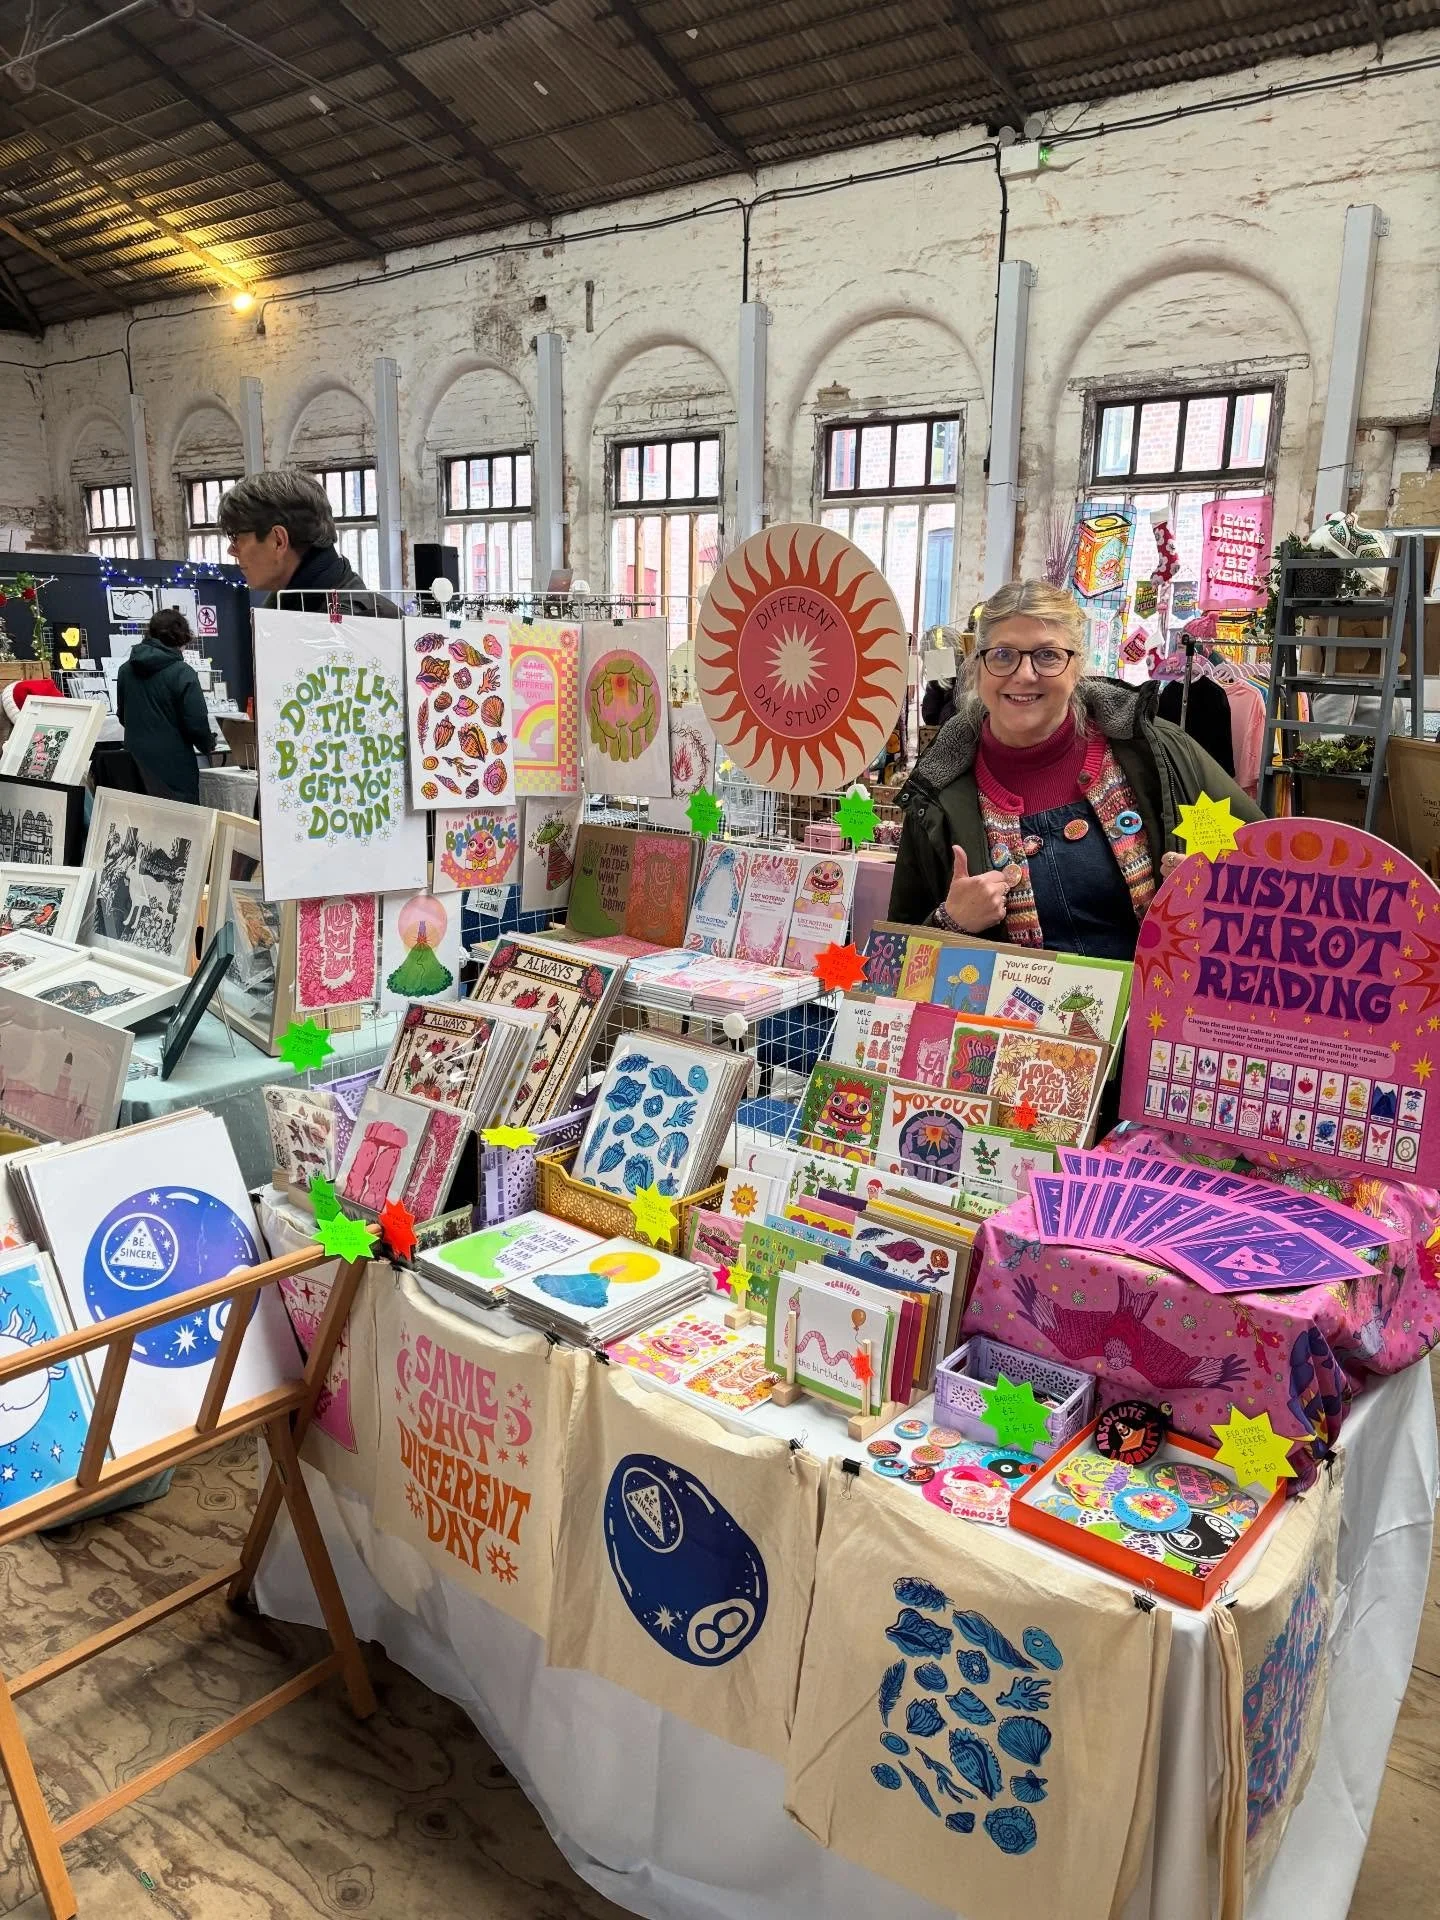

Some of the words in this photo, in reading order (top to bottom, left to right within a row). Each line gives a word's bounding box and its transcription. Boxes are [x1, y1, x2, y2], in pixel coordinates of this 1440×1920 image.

[1221, 513, 1256, 530] EAT
[1210, 525, 1266, 548] DRINK
[1217, 543, 1256, 559] AND
[1223, 556, 1248, 572] BE
[1207, 567, 1263, 590] MERRY
[756, 595, 838, 632] DIFFERENT
[513, 679, 553, 690] DIFFERENT
[281, 666, 350, 736] DON'T
[354, 667, 398, 717] LET
[753, 684, 781, 718] DAY
[785, 687, 840, 727] STUDIO
[316, 697, 366, 737] THE
[299, 772, 347, 802] GET
[350, 767, 391, 806] YOU
[308, 795, 391, 839] DOWN
[610, 843, 628, 857] HAVE
[599, 872, 620, 883] WHAT
[606, 886, 618, 898] AM
[762, 894, 785, 903] NOTEPAD
[1203, 862, 1410, 925] INSTANT
[602, 900, 625, 912] DOING
[870, 935, 894, 960] SO
[1202, 909, 1402, 978] TAROT
[524, 956, 574, 979] ALWAYS
[914, 956, 929, 968] SO
[1005, 960, 1029, 969] YOU'VE
[1032, 963, 1047, 971] GOT
[1001, 971, 1022, 982] FULL
[1024, 976, 1051, 986] HOUSE
[1013, 988, 1045, 1014] BINGO
[1193, 956, 1397, 1025] READING
[430, 1015, 468, 1031] ALWAYS
[1188, 1018, 1209, 1027] Choose
[1211, 1021, 1220, 1029] the
[1221, 1023, 1235, 1031] card
[1237, 1026, 1249, 1034] that
[1250, 1028, 1264, 1037] calls
[1273, 1034, 1285, 1043] you
[1285, 1034, 1298, 1042] and
[1320, 1041, 1342, 1050] instant
[1344, 1044, 1362, 1053] Tarot
[1199, 1027, 1212, 1035] Take
[1232, 1033, 1246, 1041] your
[1247, 1034, 1275, 1045] beautiful
[1276, 1040, 1293, 1049] Tarot
[1294, 1043, 1308, 1051] card
[1310, 1046, 1326, 1056] print
[1326, 1048, 1339, 1056] and
[1340, 1051, 1351, 1060] pin
[1218, 1038, 1246, 1048] reminder
[1253, 1044, 1264, 1052] the
[1265, 1046, 1293, 1057] guidance
[1294, 1051, 1317, 1061] offered
[1326, 1058, 1339, 1066] you
[1018, 1063, 1065, 1091] HAPPY
[1020, 1085, 1065, 1104] BIRTH
[893, 1089, 989, 1127] JOYOUS
[132, 1237, 144, 1246] BE
[514, 1239, 549, 1254] WHAT
[552, 1232, 580, 1246] HAVE
[752, 1235, 795, 1259] nothing
[119, 1248, 157, 1260] SINCERE
[750, 1248, 786, 1270] really
[414, 1335, 498, 1421] SAME
[798, 1358, 811, 1370] the
[812, 1361, 850, 1387] birthday
[994, 1393, 1021, 1403] BADGES
[416, 1390, 497, 1466] SHIT
[1004, 1425, 1009, 1433] 3
[1022, 1423, 1035, 1433] £5
[1097, 1406, 1146, 1449] ABSOLUTE
[1226, 1429, 1240, 1438] ECO
[1241, 1425, 1261, 1435] VINYL
[1110, 1421, 1159, 1463] LIABILITY
[1235, 1434, 1267, 1446] STICKERS
[992, 1450, 1031, 1459] MENACE
[1241, 1448, 1255, 1457] £3
[397, 1417, 531, 1546] DIFFERENT
[633, 1492, 662, 1530] SINCERE
[643, 1493, 656, 1508] BE
[953, 1507, 995, 1520] CHAOS
[425, 1495, 487, 1575] DAY
